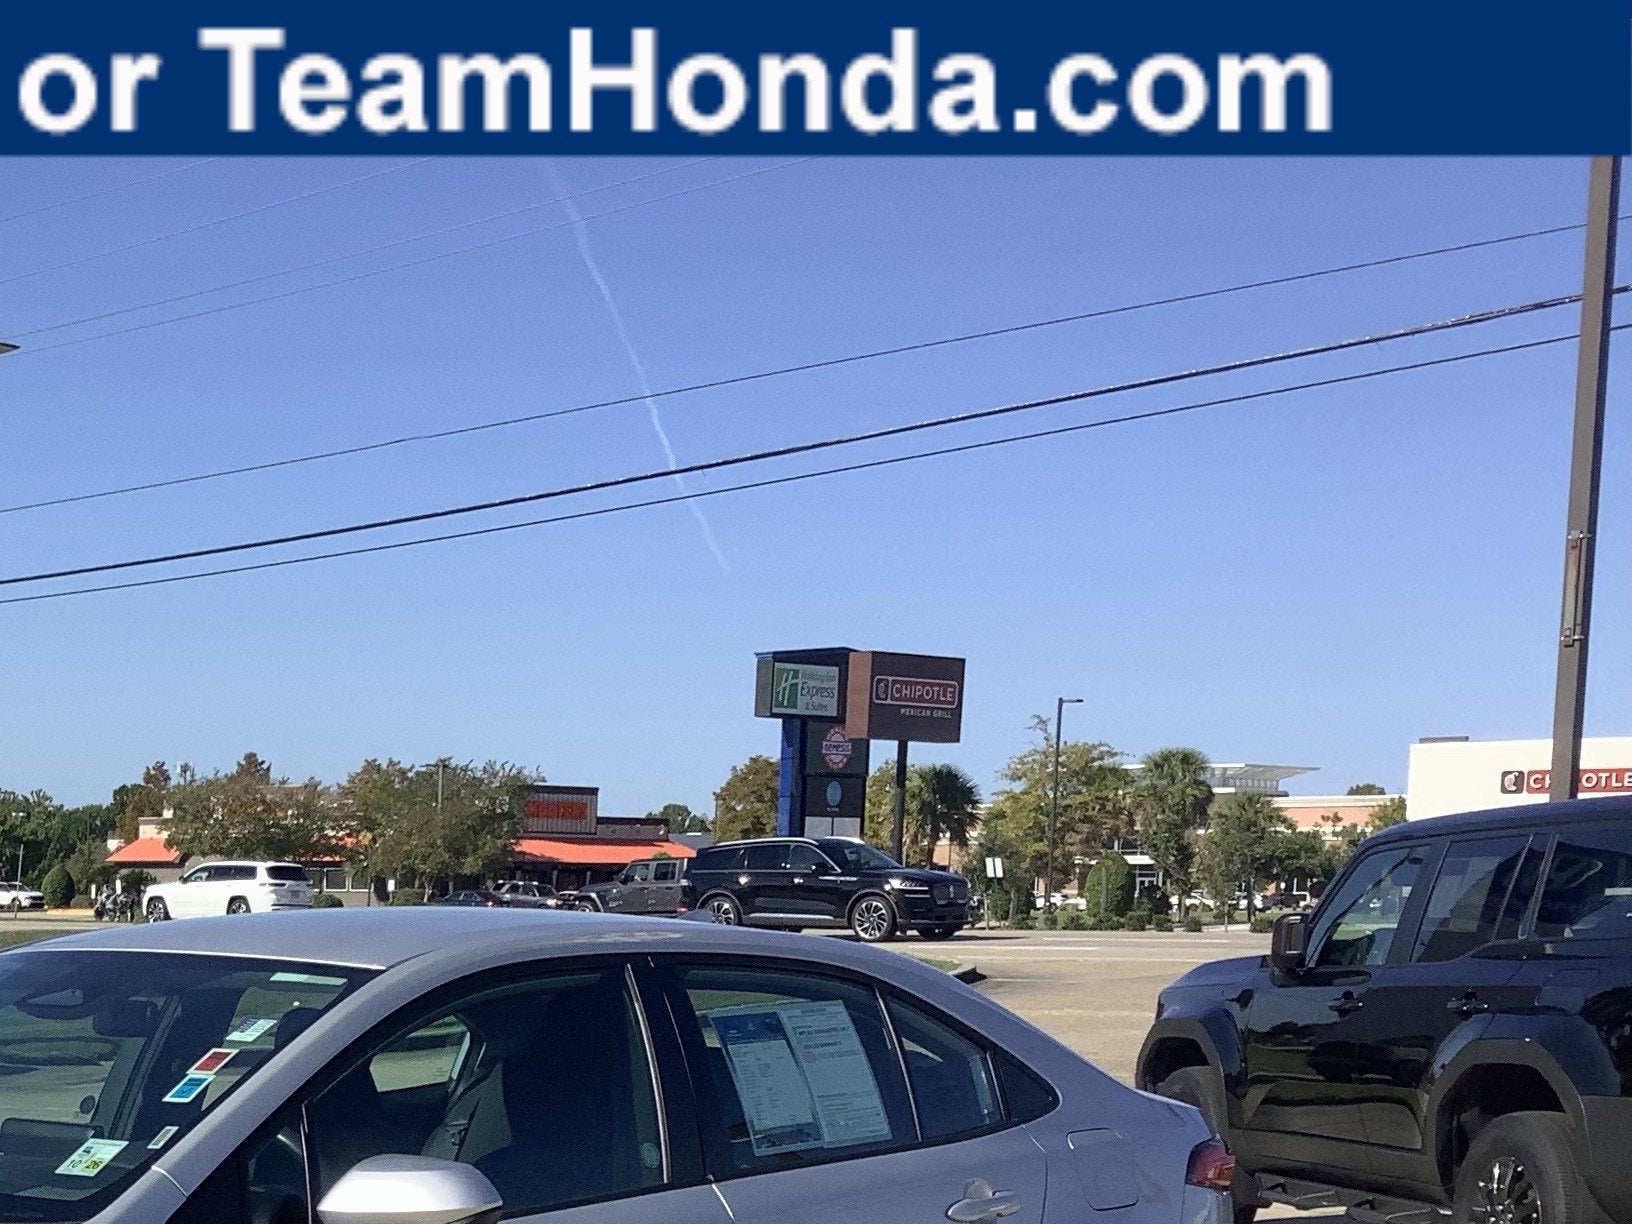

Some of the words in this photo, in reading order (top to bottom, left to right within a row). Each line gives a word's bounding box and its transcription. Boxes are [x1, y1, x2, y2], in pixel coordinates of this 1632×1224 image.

[800, 681, 835, 700] Express
[892, 683, 955, 702] CHIPOTLE
[1529, 772, 1632, 789] COTLE
